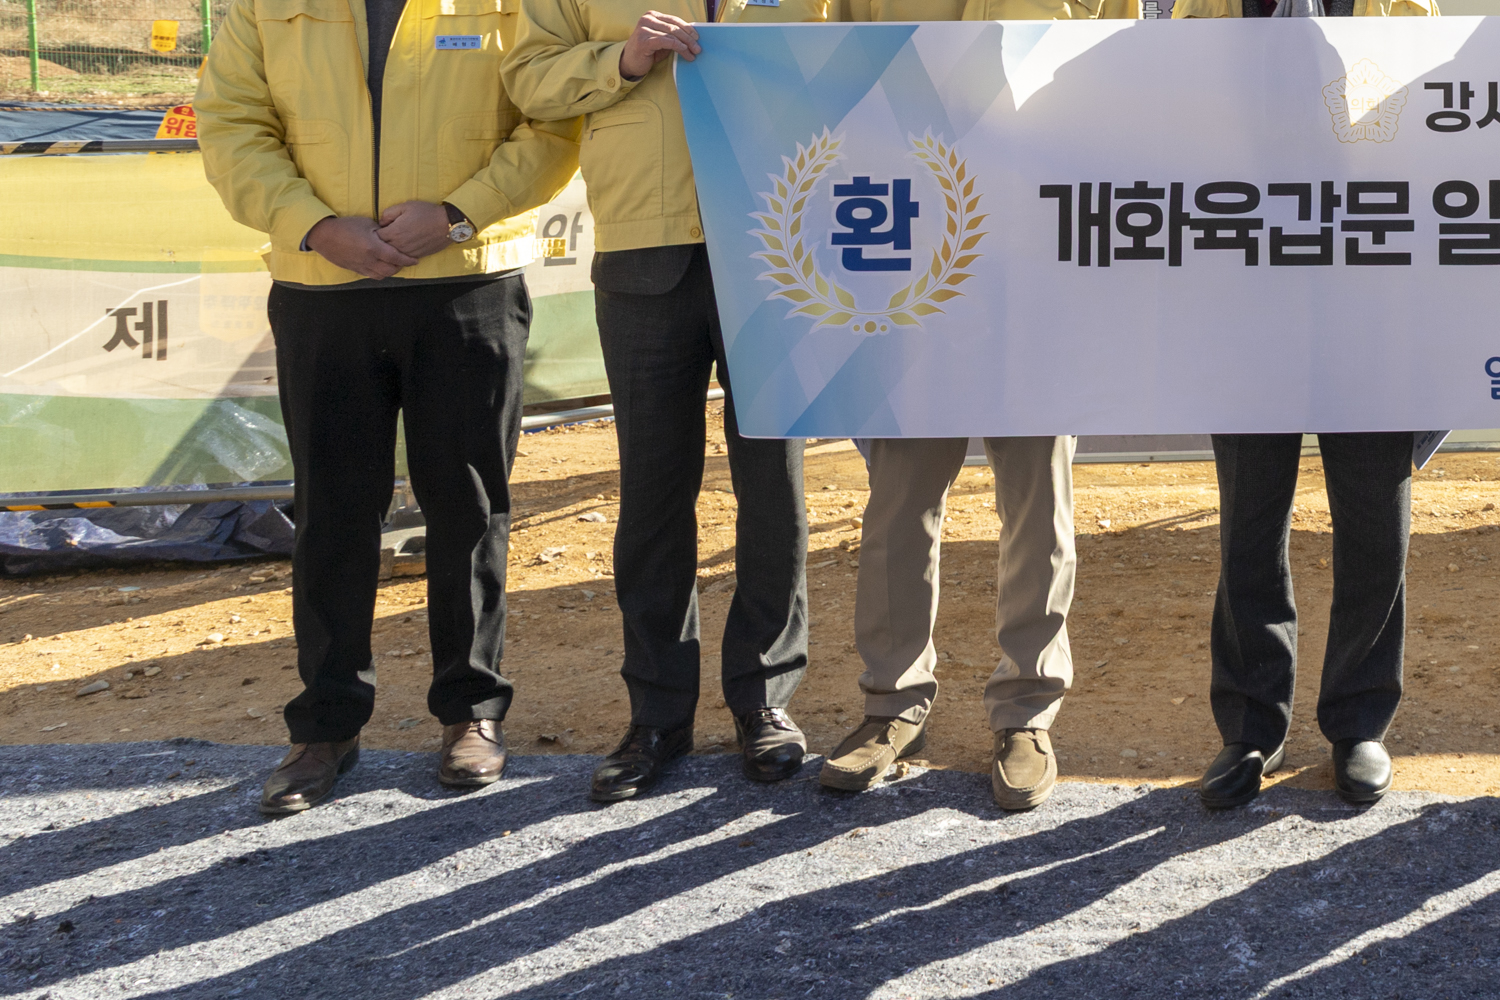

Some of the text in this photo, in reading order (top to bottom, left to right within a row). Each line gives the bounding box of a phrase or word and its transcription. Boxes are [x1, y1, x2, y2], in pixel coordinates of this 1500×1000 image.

[1350, 97, 1380, 114] 의회
[542, 212, 583, 267] 안
[829, 175, 920, 273] 환
[1039, 178, 1415, 268] 개화육갑문
[102, 299, 168, 361] 제
